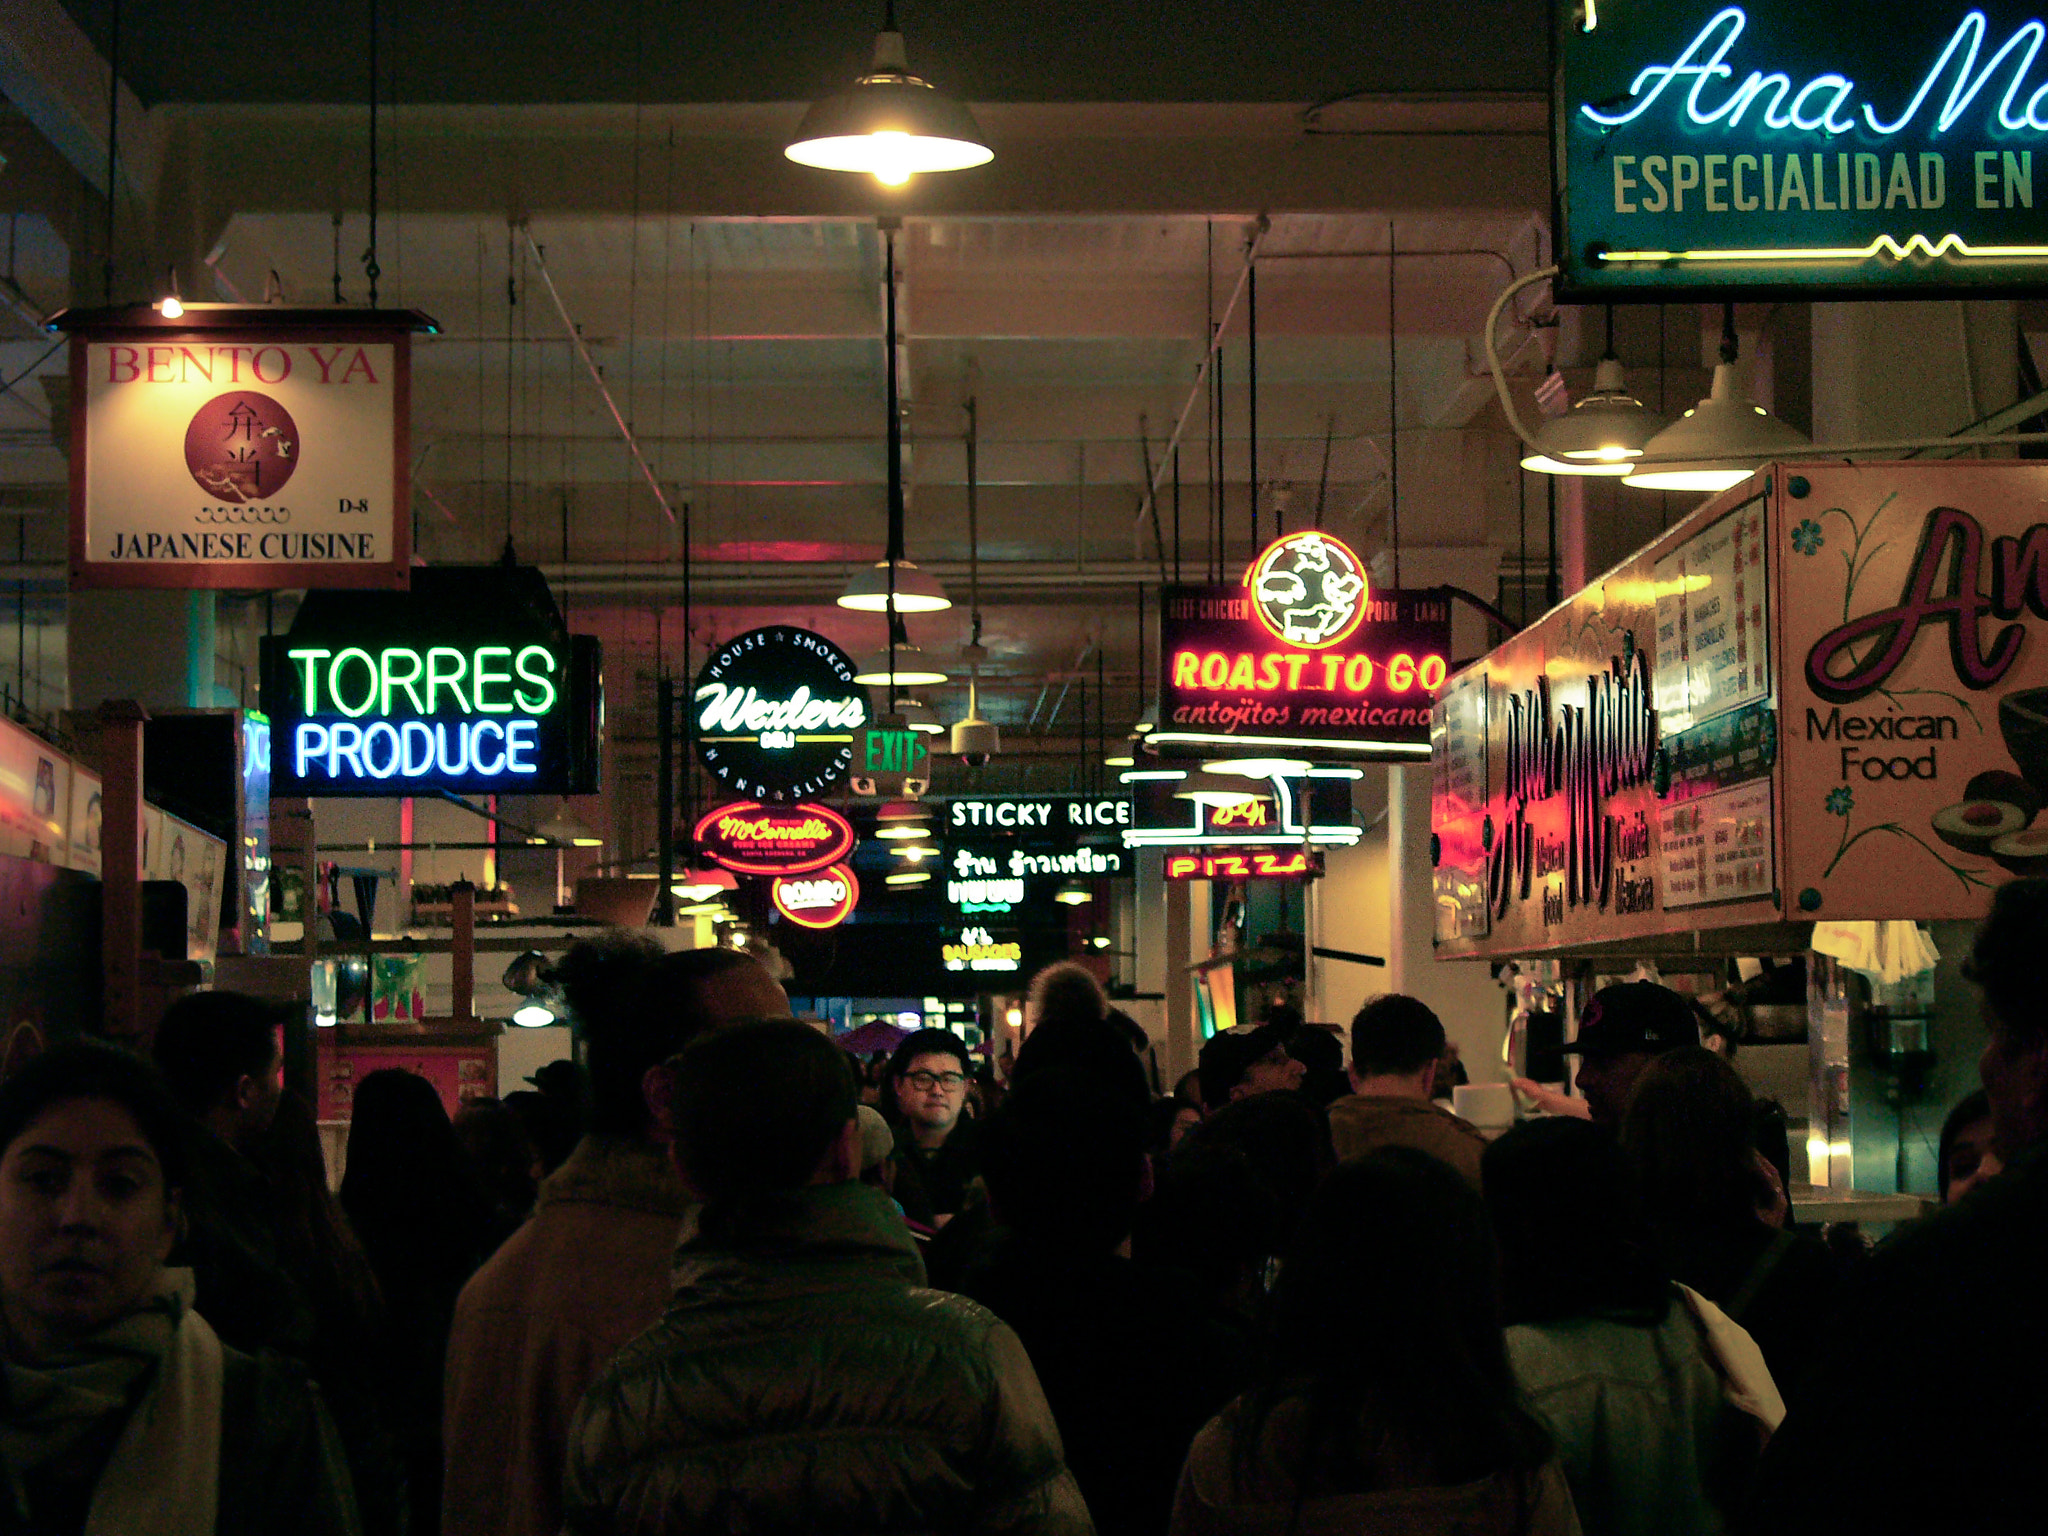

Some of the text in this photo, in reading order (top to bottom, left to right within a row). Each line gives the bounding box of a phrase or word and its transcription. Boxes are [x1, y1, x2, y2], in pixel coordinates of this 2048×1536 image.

[1582, 8, 1855, 134] Ana
[1613, 151, 2033, 213] ESPECIALIDAD EN
[108, 346, 379, 384] BENTO YA
[220, 400, 264, 488] 弁当
[338, 499, 369, 514] D-8
[110, 533, 375, 560] JAPANESE CUISINE
[1200, 599, 1249, 620] CHICKEN
[1366, 600, 1398, 622] PORK
[711, 633, 852, 682] HOUSE SMOKED
[1174, 651, 1447, 692] ROAST TO GO
[288, 645, 557, 718] TORRES
[1173, 698, 1290, 733] antojitos
[1806, 707, 1958, 742] Mexican
[295, 720, 539, 778] PRODUCE
[865, 730, 918, 773] EXIT
[1841, 746, 1937, 780] Food
[706, 748, 853, 798] HAND SLICED
[952, 801, 1130, 826] STICKY RICE
[1171, 854, 1307, 878] PIZZA
